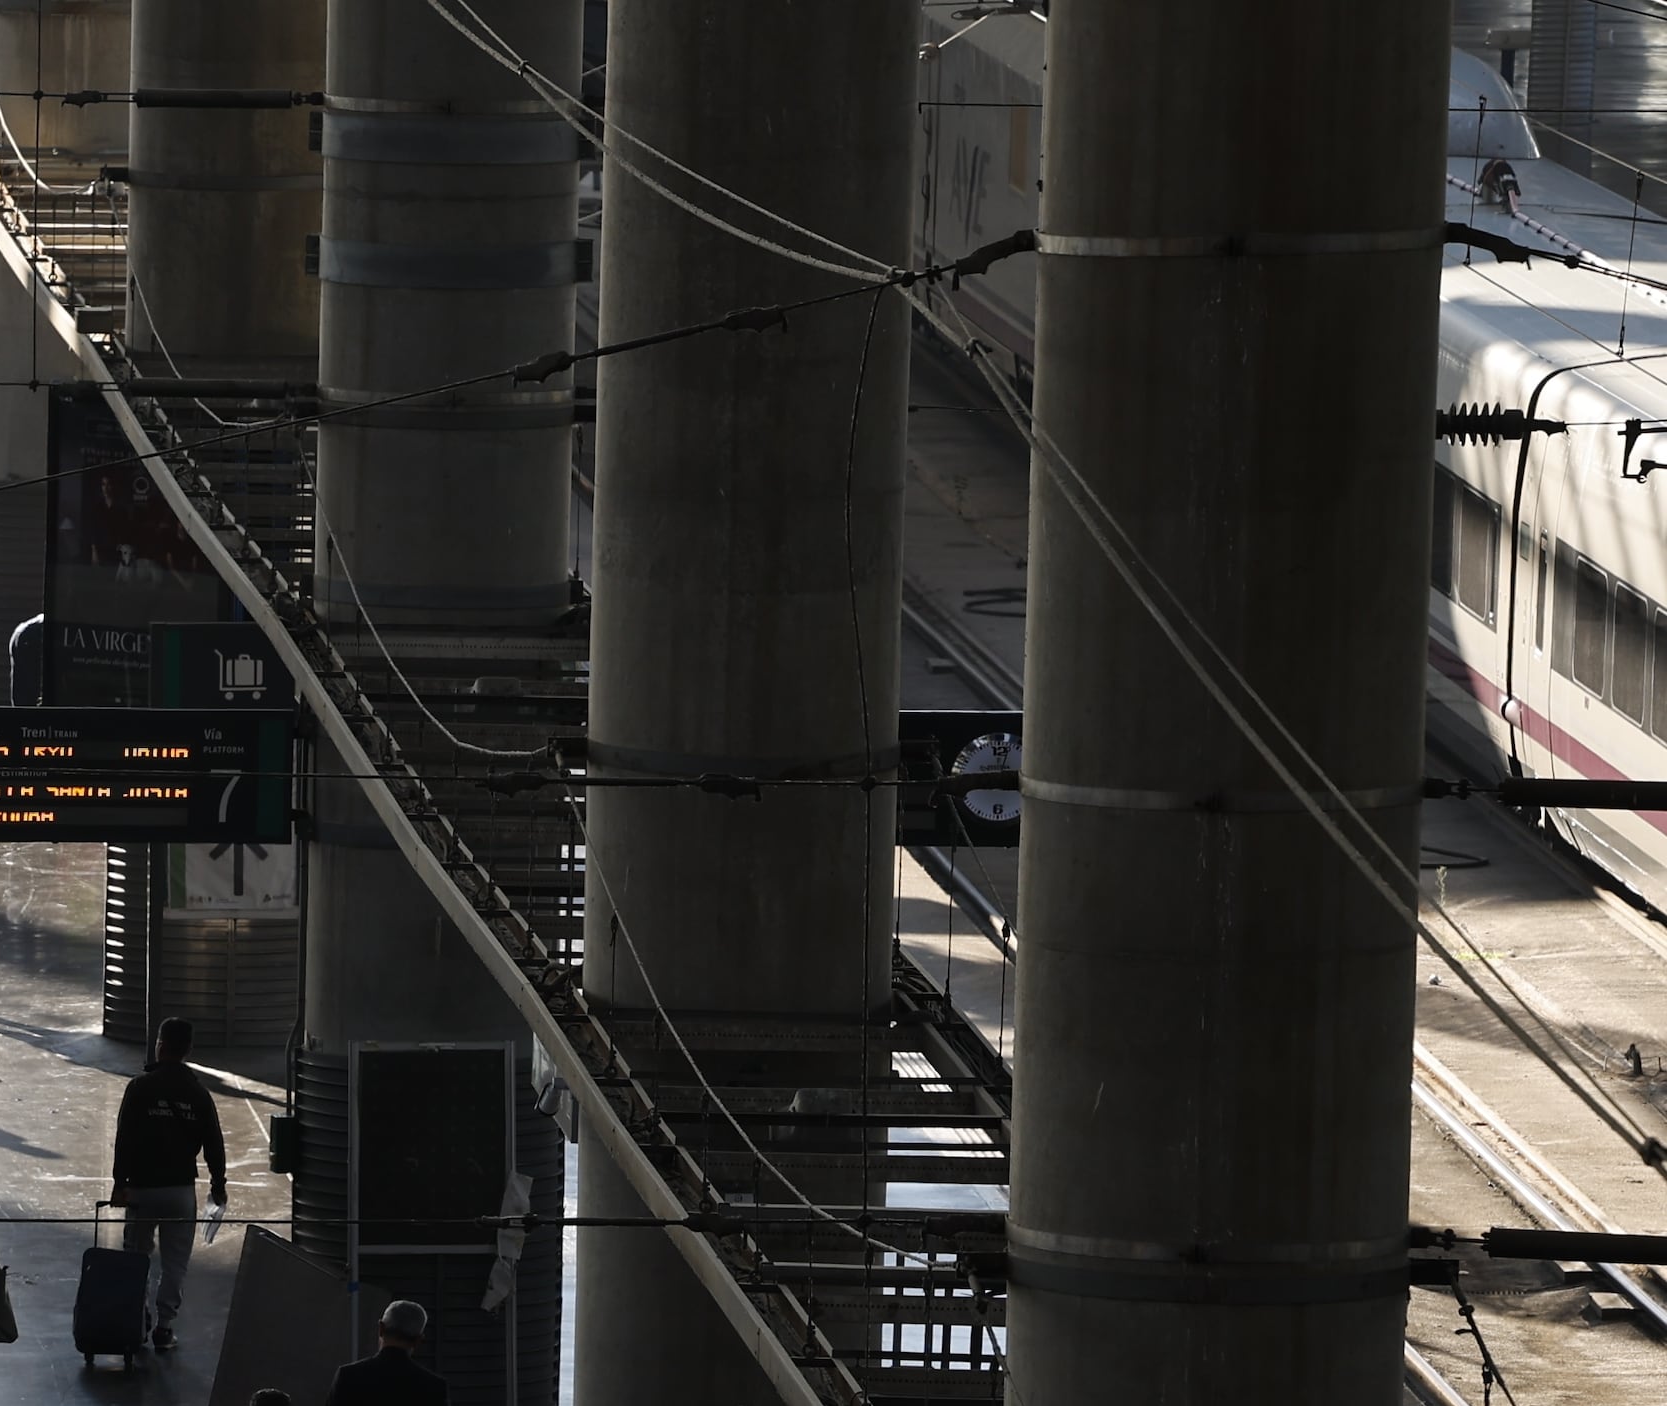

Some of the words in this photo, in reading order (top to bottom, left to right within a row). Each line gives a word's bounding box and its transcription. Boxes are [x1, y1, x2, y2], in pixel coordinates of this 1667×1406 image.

[64, 627, 85, 648] LA
[20, 726, 46, 738] Tren
[54, 730, 78, 738] TRAIN
[203, 728, 223, 740] Vía
[202, 745, 244, 753] PLATFORM
[992, 746, 1008, 756] 12
[210, 768, 242, 823] 7
[993, 803, 1004, 814] 6
